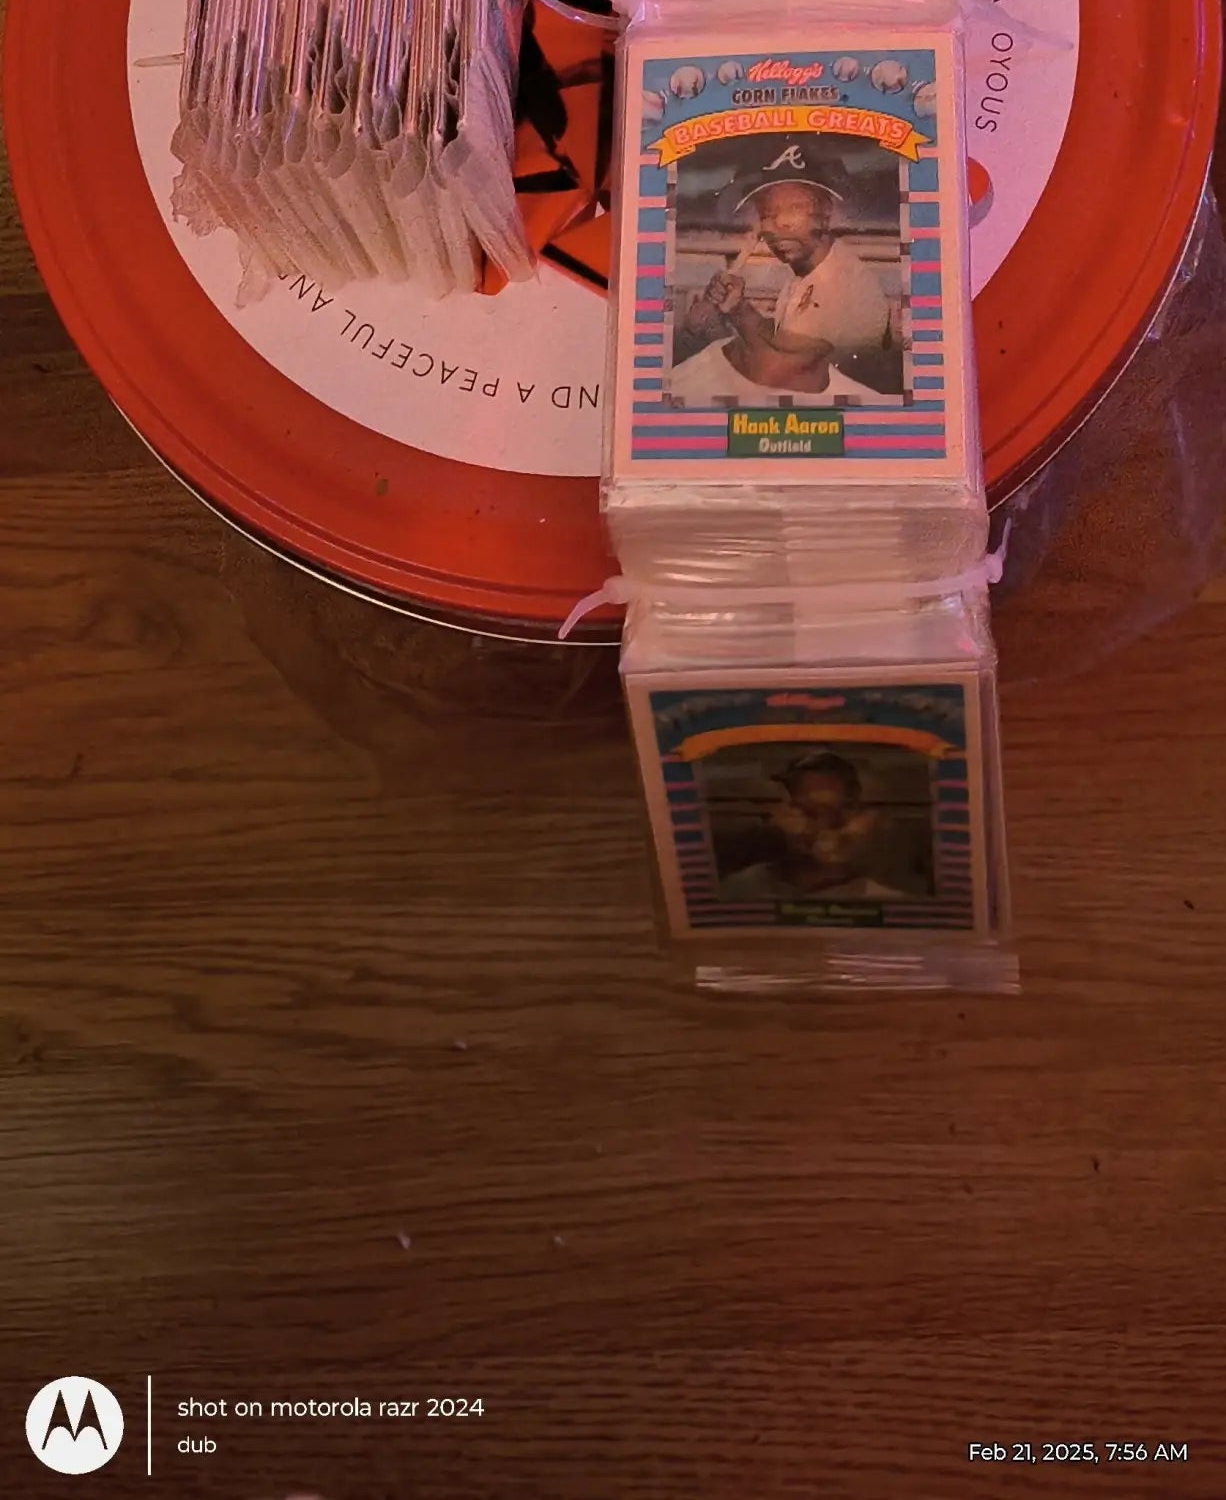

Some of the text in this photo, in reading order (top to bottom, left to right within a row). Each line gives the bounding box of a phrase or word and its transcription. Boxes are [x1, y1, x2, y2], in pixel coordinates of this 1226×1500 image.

[747, 58, 824, 85] Kellogg's
[975, 32, 1013, 133] OYOUS
[731, 88, 777, 106] CORN
[674, 110, 906, 146] BASEBALL GREATS
[340, 309, 500, 397] PEACEFUL
[516, 382, 535, 404] A
[733, 412, 840, 434] Hank Aaron
[759, 437, 812, 453] Outfield
